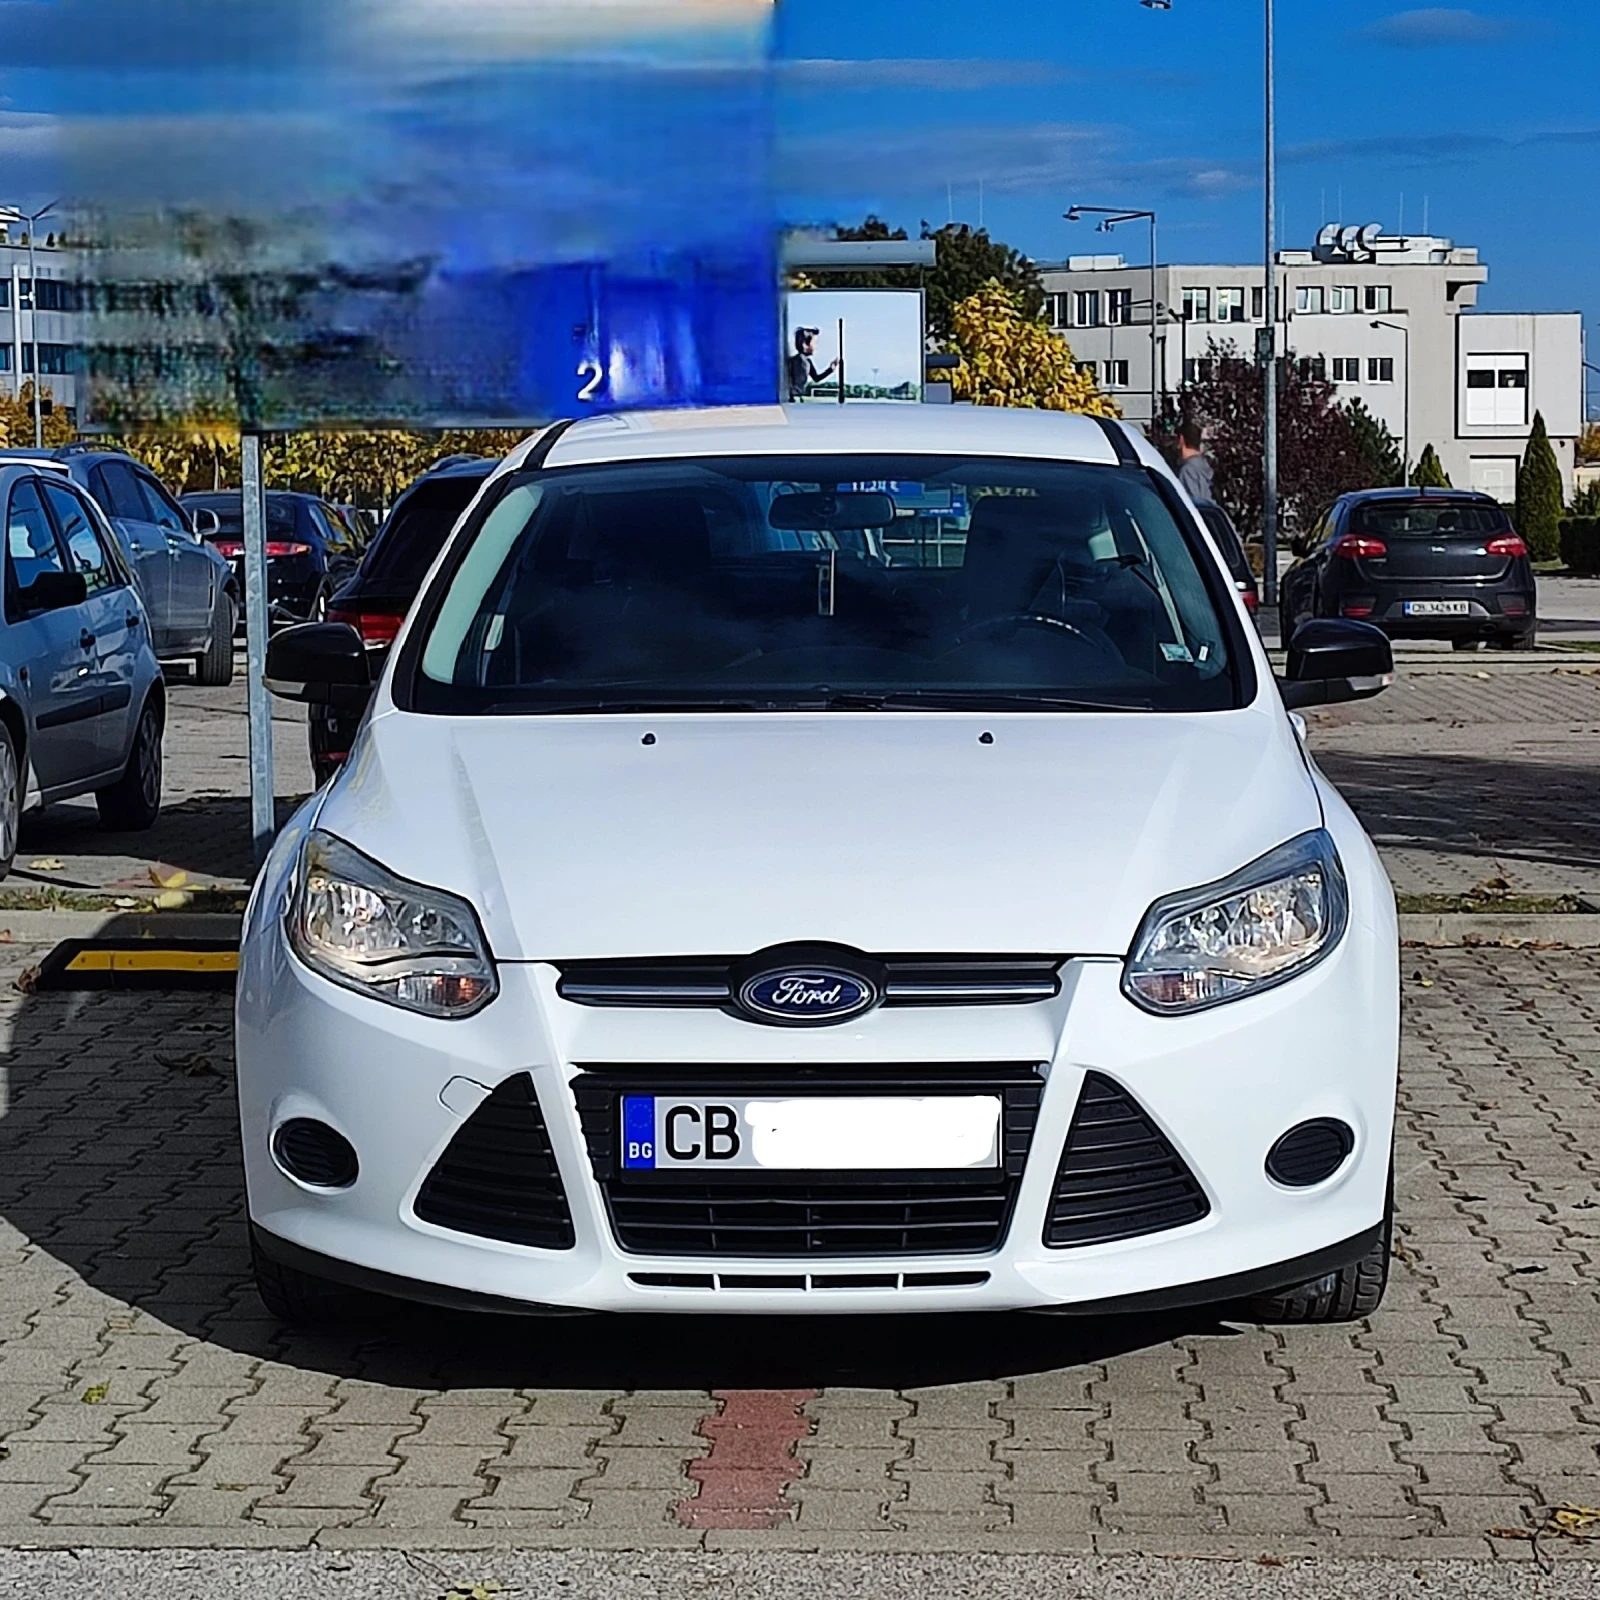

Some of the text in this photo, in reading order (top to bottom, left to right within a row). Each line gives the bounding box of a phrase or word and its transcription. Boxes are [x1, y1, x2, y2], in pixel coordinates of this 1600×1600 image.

[772, 977, 841, 1004] Ford
[629, 1105, 740, 1160] BG CB
